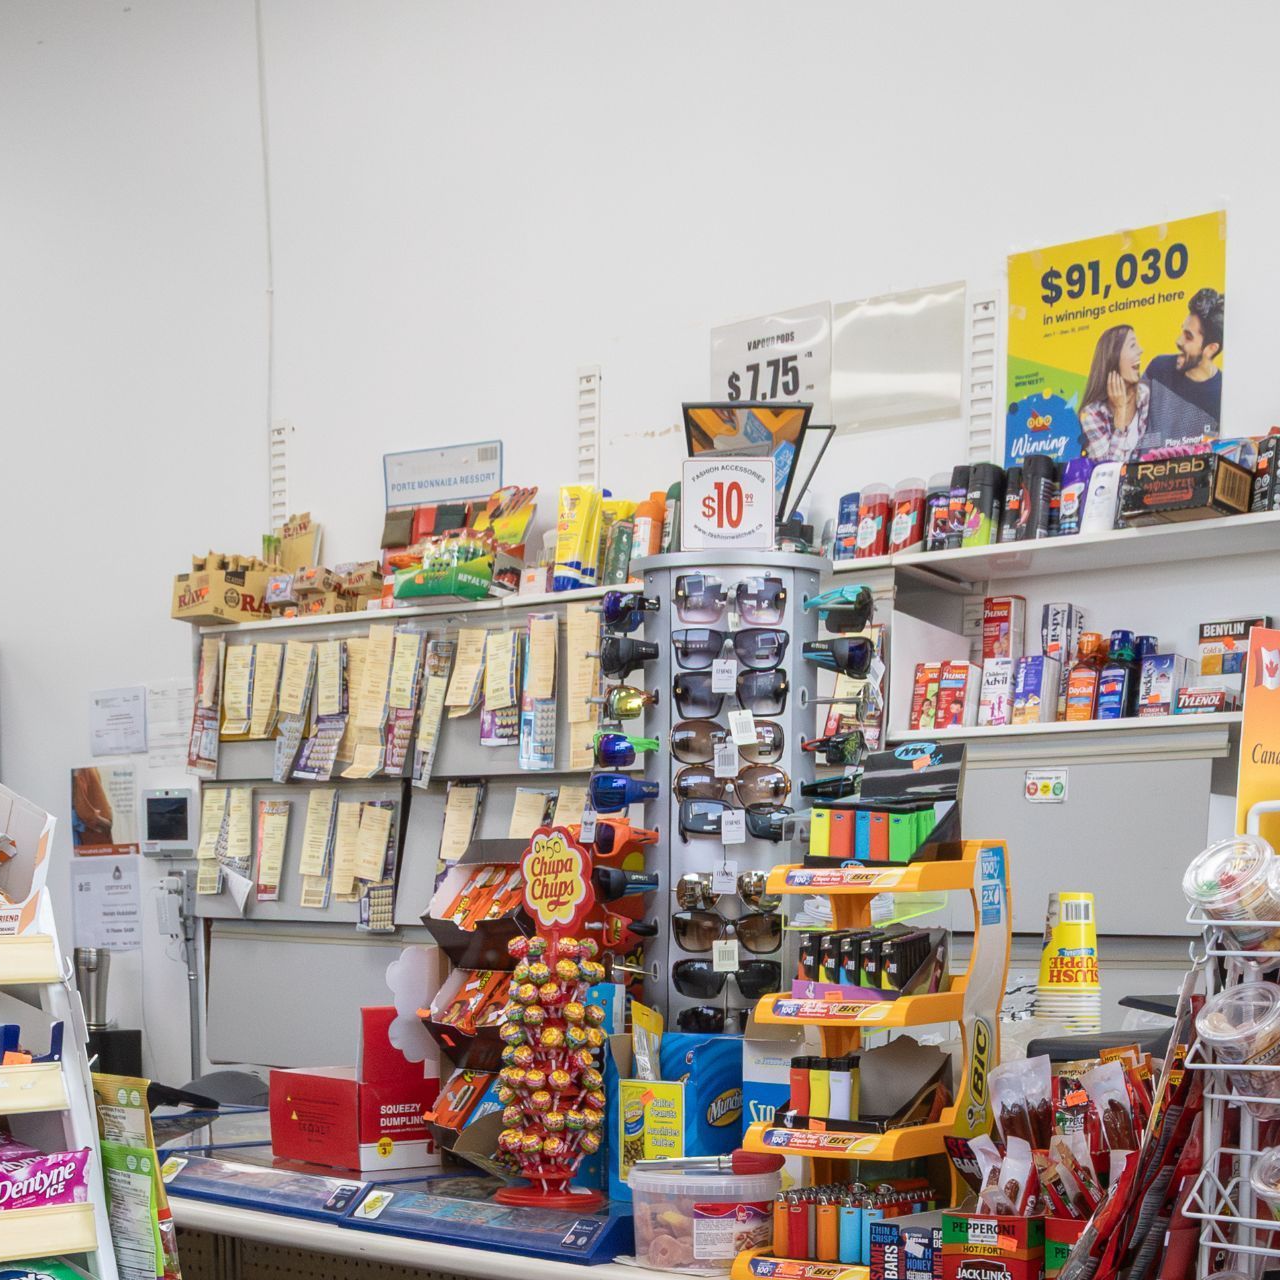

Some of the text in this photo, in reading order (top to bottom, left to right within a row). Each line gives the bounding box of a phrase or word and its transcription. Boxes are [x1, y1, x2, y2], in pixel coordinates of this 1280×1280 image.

[1041, 242, 1189, 308] $91,030
[1043, 290, 1185, 328] in winnings claimed here
[1011, 433, 1070, 457] Winning
[721, 465, 766, 484] ACCESSORIES
[1137, 457, 1204, 480] Rehab
[283, 522, 311, 539] RAW
[1203, 622, 1246, 637] BENYLIN
[984, 677, 1008, 687] Advil
[1178, 695, 1221, 707] TYLENOL
[530, 856, 573, 880] Chupa
[530, 879, 574, 899] Chups
[971, 1028, 990, 1099] BIC
[380, 1103, 420, 1115] SQUEEZY
[45, 1180, 66, 1198] ICE
[952, 1222, 1015, 1235] PEPPERONI
[871, 1234, 898, 1243] CRISPY
[956, 1267, 979, 1279] JACK
